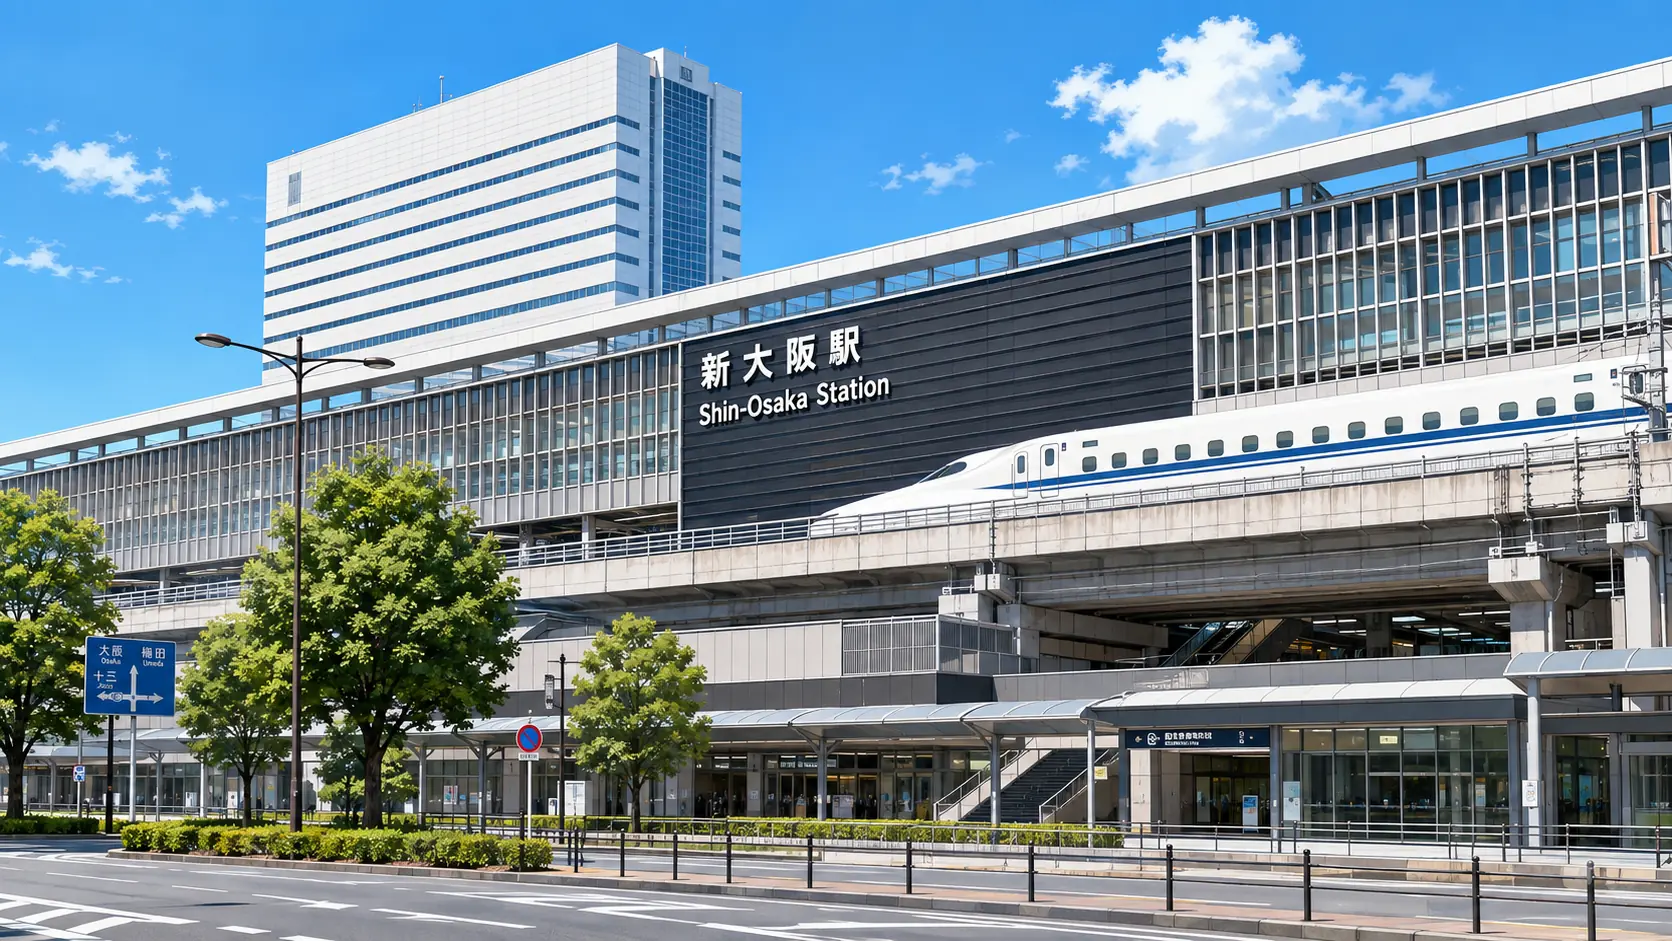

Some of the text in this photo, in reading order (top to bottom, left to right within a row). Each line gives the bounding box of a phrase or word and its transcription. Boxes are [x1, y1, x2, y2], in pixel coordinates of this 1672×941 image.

[701, 325, 860, 389] 新大阪駅
[699, 375, 889, 426] Shin-Osaka Station
[93, 670, 117, 682] 十三
